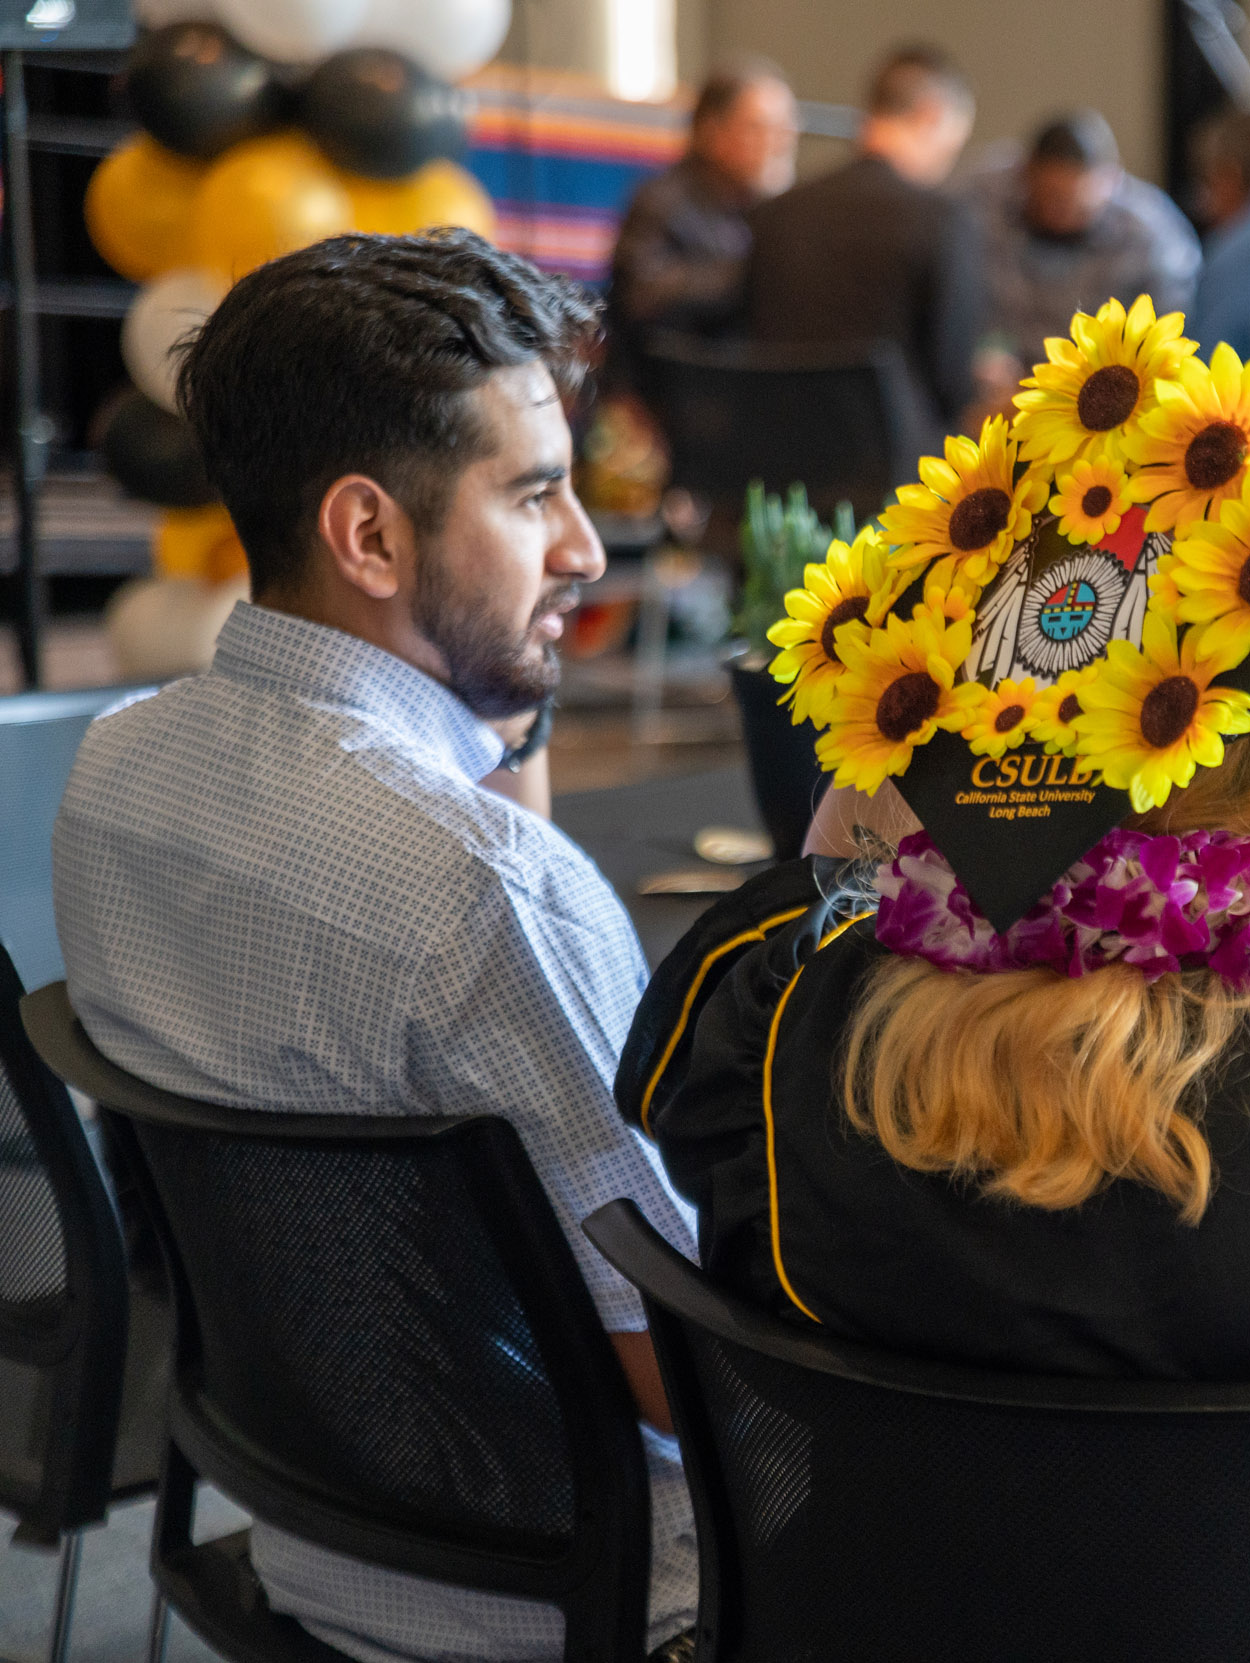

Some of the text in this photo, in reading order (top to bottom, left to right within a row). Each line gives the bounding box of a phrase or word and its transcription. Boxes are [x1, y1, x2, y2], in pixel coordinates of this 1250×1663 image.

[955, 789, 1096, 805] California State University
[989, 804, 1051, 820] Long Beach
